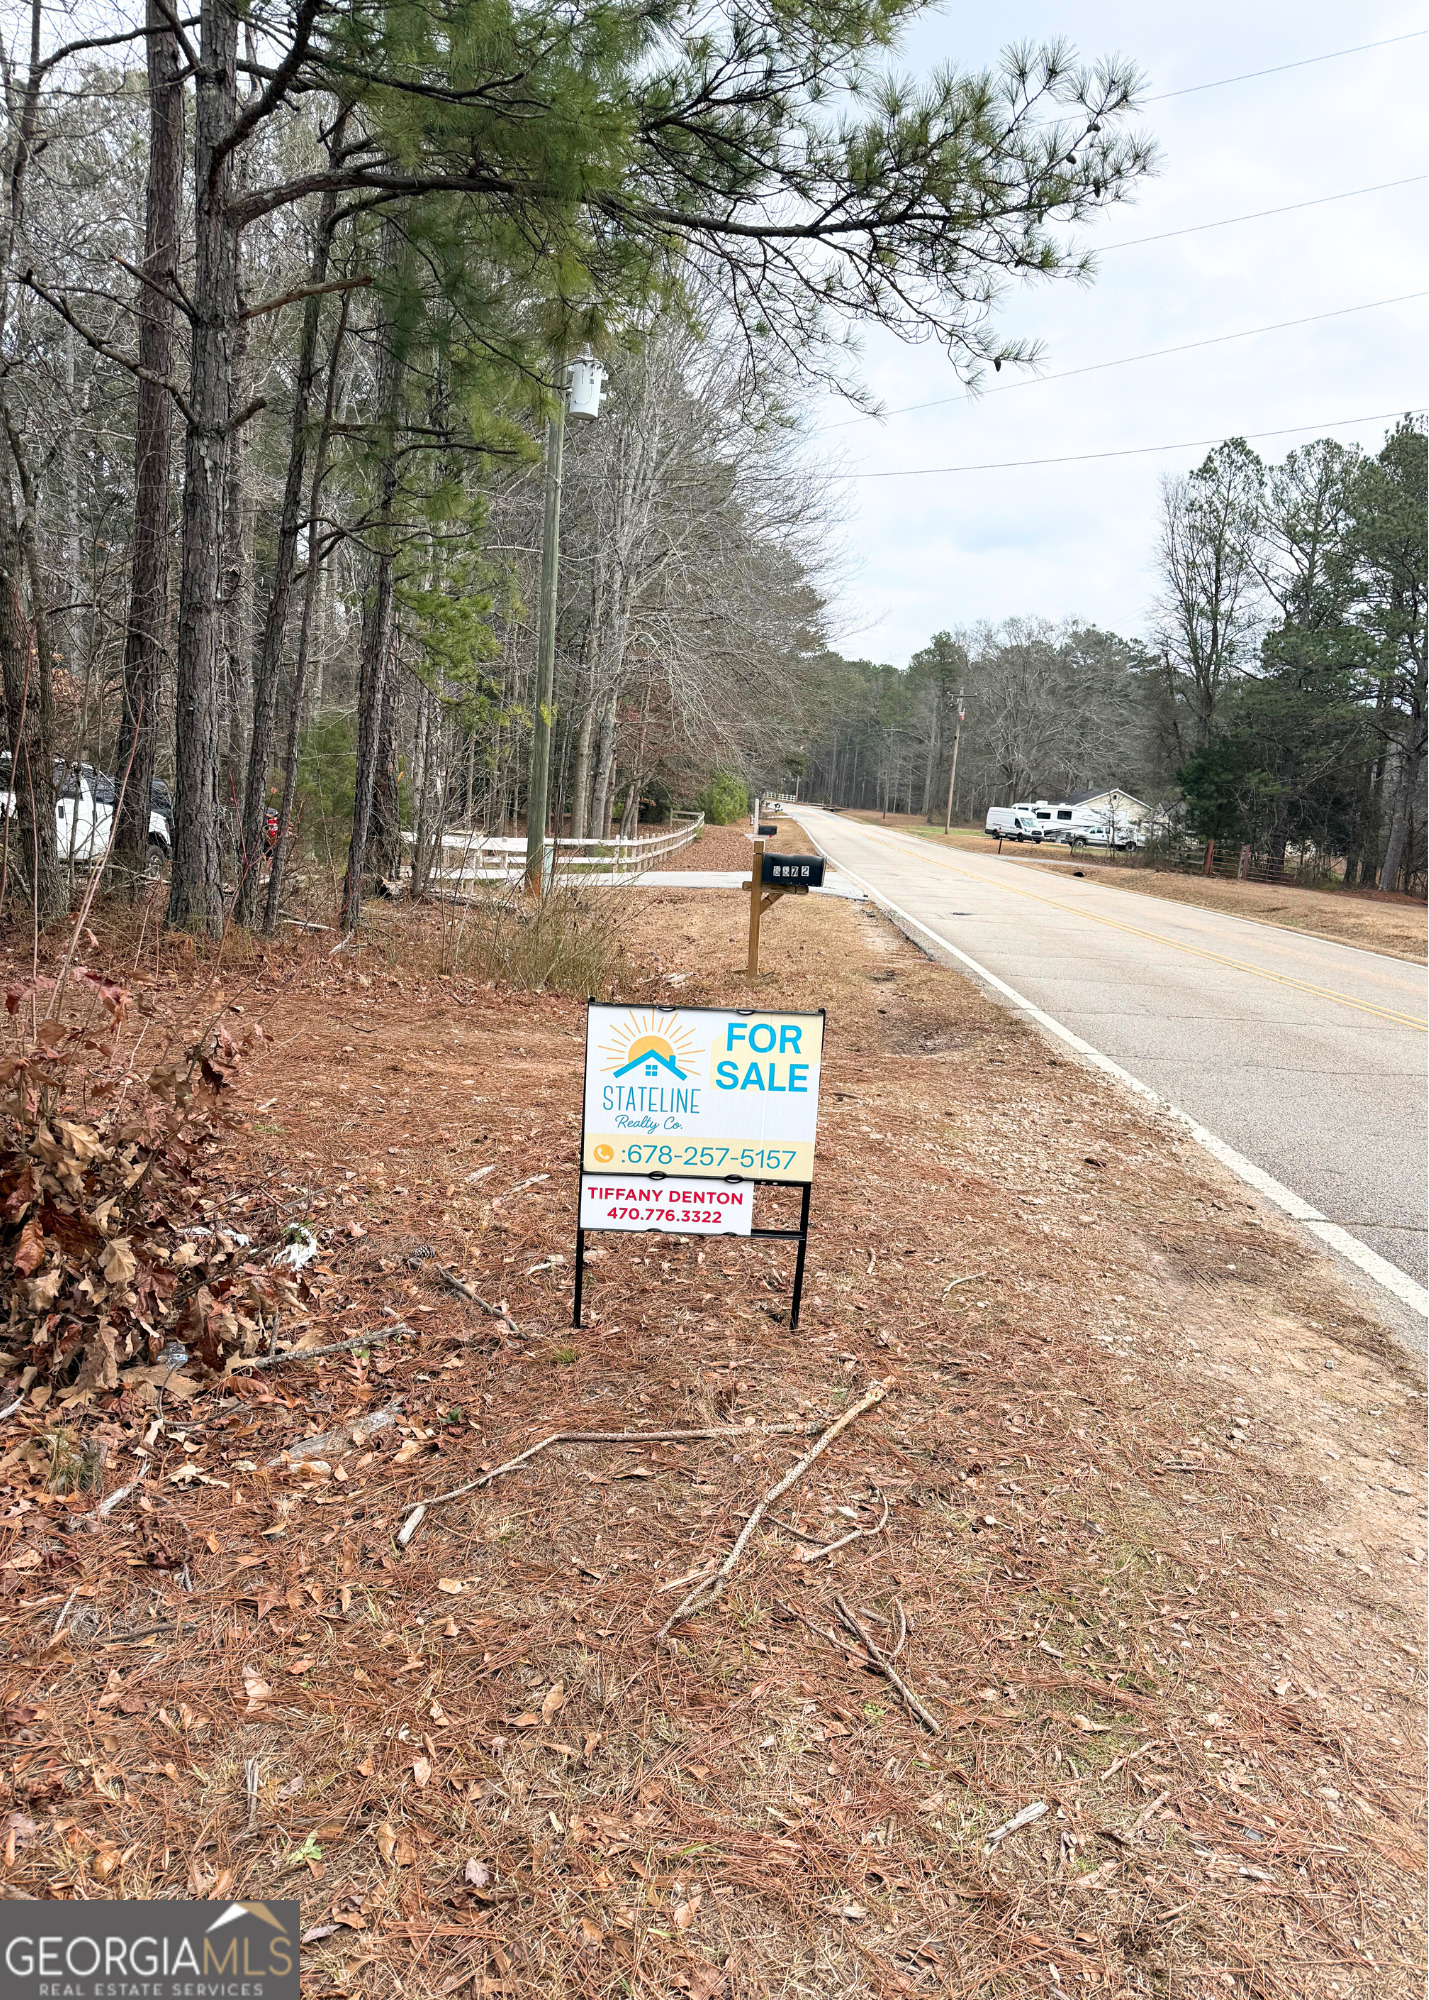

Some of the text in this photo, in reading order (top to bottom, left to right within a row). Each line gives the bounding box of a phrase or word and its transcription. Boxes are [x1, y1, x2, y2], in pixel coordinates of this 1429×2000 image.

[726, 1022, 802, 1054] FOR
[716, 1061, 809, 1093] SALE
[603, 1085, 701, 1114] STATELINE
[615, 1114, 683, 1134] Realty Co.
[588, 1186, 743, 1205] TIFFANY DENTON
[607, 1208, 722, 1224] 470.776.3322
